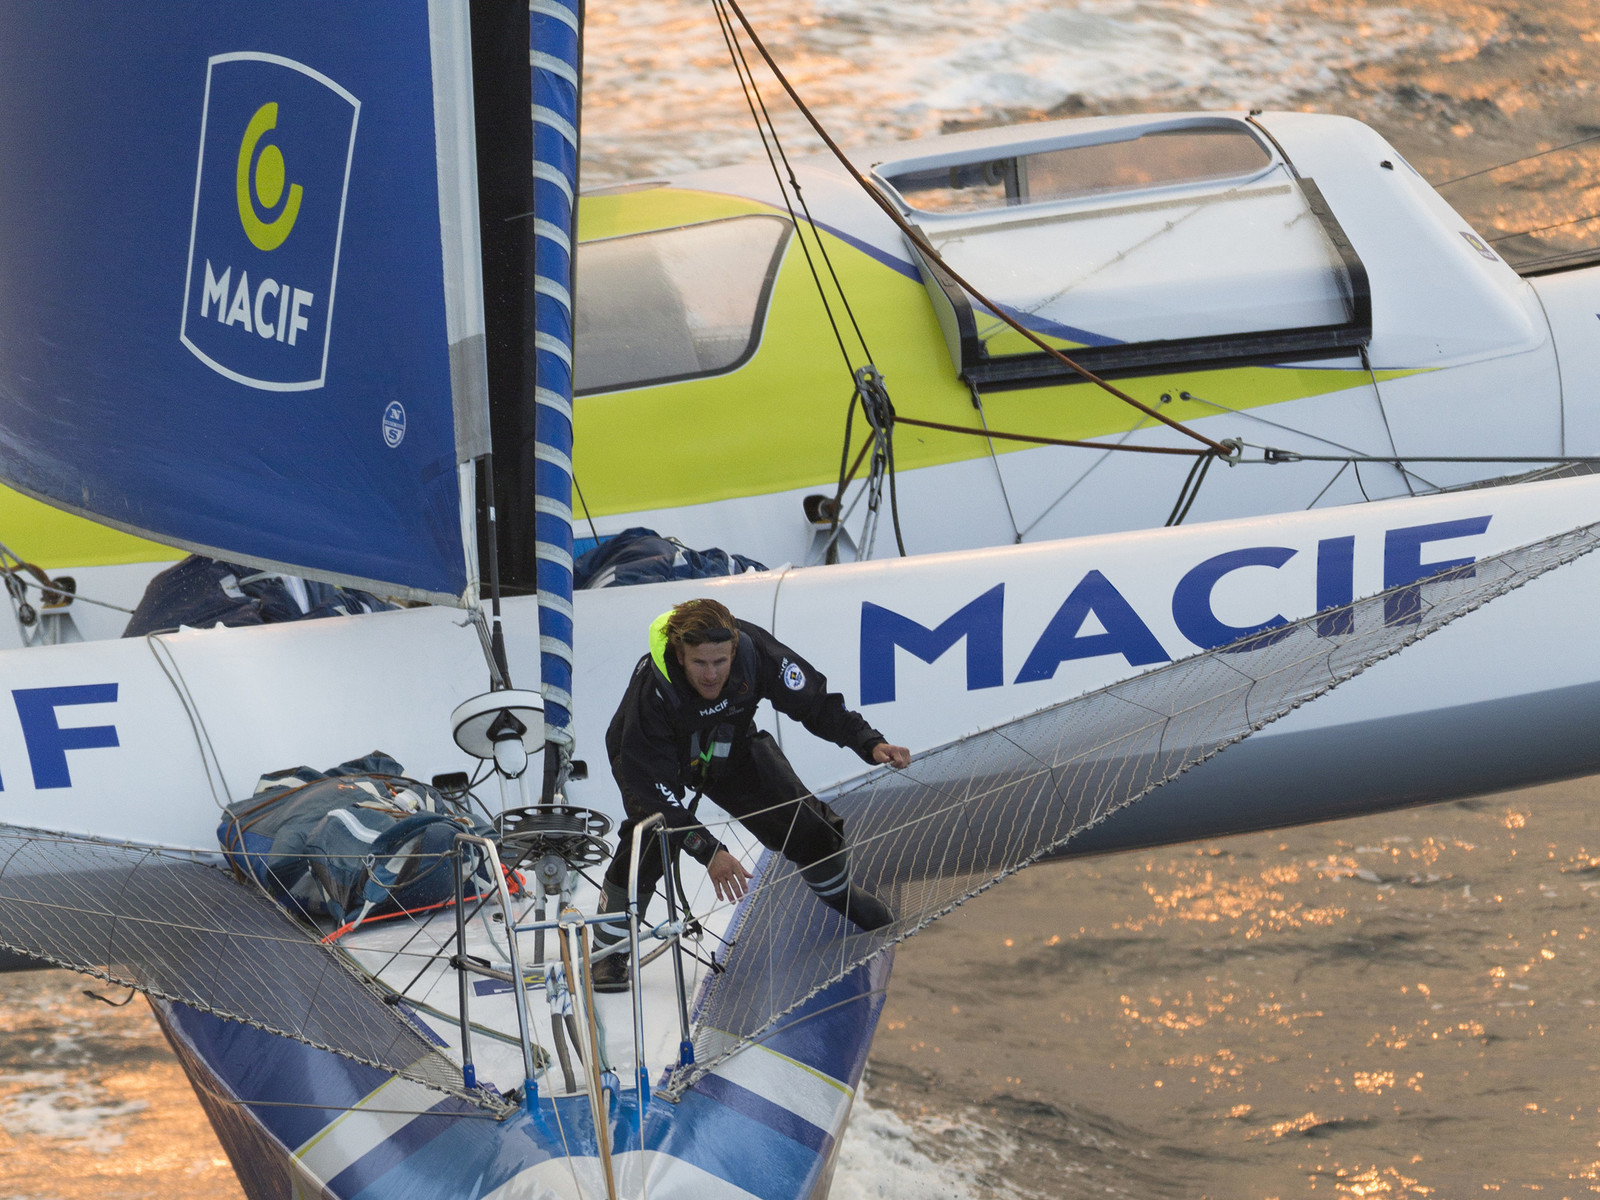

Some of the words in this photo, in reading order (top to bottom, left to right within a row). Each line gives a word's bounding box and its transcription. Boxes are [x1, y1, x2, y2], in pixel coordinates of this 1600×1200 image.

[200, 258, 314, 347] MACIF
[860, 515, 1493, 705] MACIF
[0, 682, 120, 792] F
[699, 698, 729, 717] MACIF
